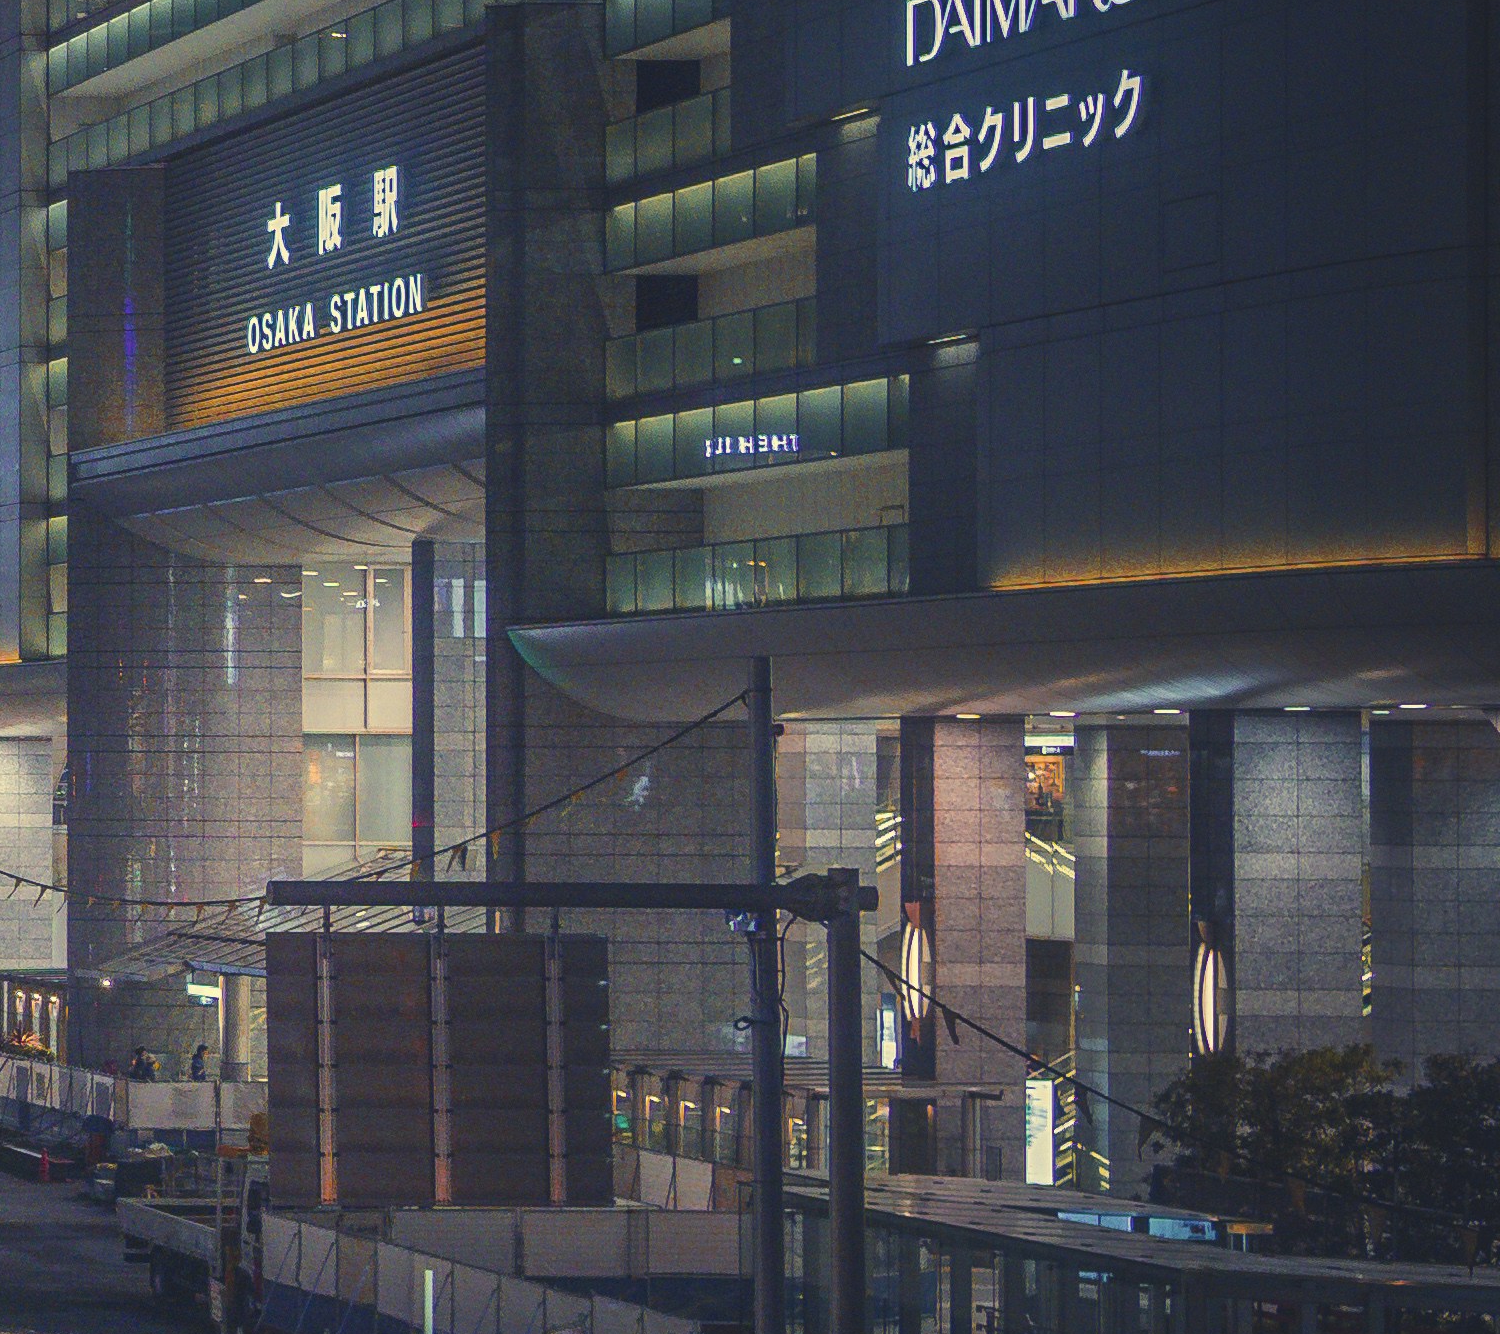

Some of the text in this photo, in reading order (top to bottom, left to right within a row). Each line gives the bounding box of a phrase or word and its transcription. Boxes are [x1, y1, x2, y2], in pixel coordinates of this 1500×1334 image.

[906, 68, 1144, 193] 総合クリニック
[266, 165, 400, 270] 大阪駅
[247, 273, 425, 355] OSAKA STATION
